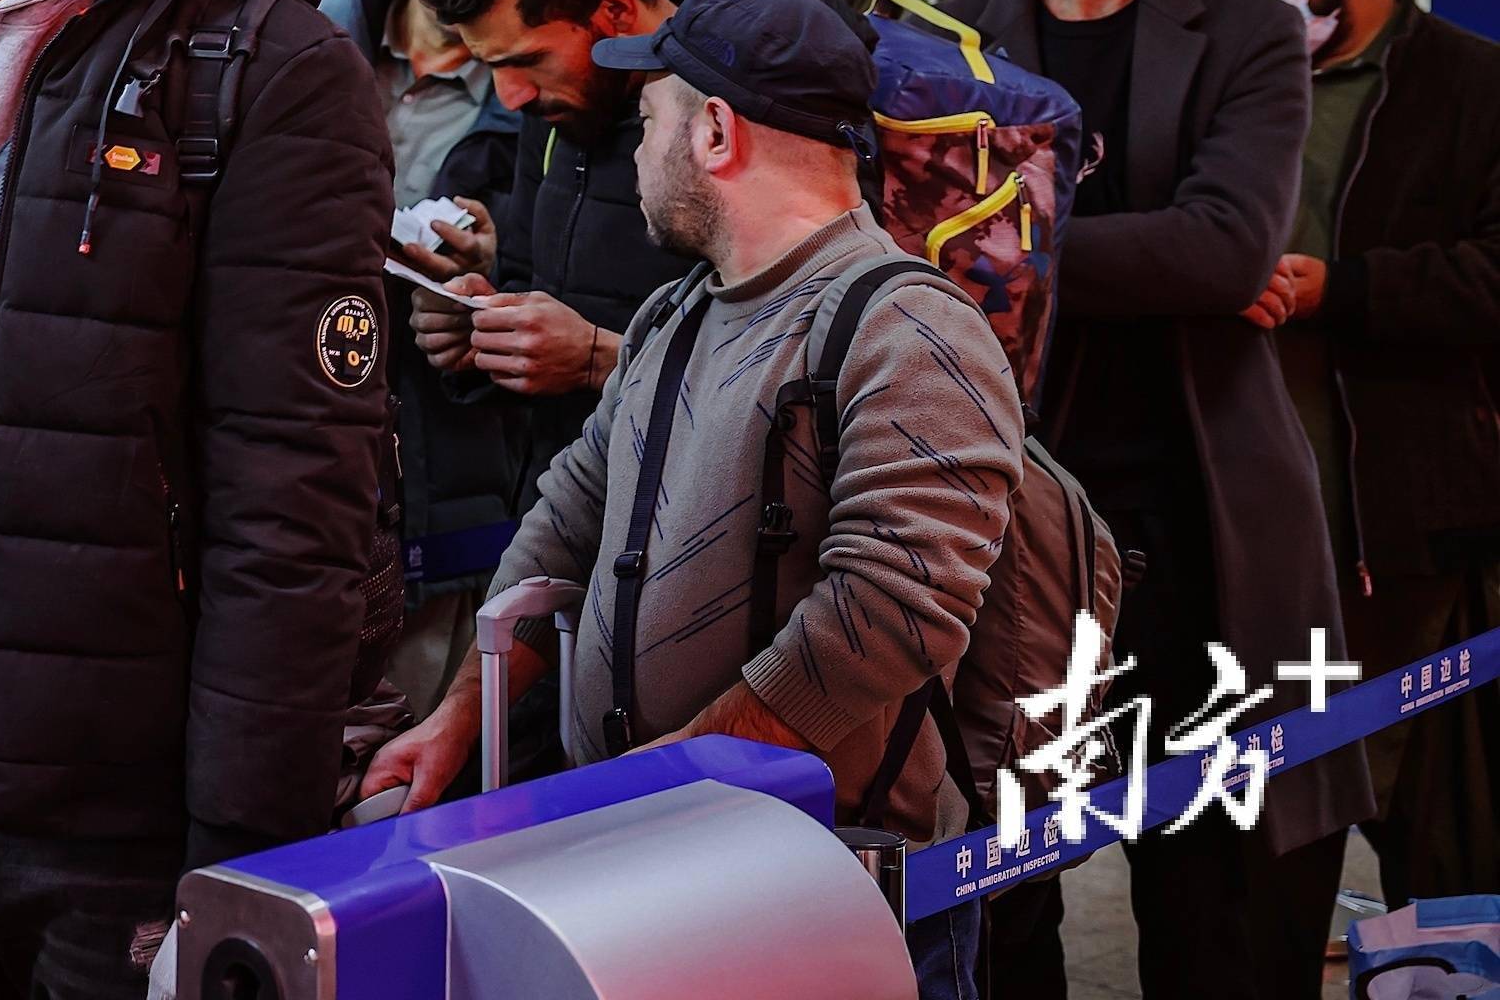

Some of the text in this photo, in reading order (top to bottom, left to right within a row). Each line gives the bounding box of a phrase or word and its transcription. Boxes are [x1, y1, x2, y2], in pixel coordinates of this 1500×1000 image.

[1400, 648, 1471, 699] 中国边检
[955, 849, 1061, 898] CHINA IMMIGRATION INSPECTION
